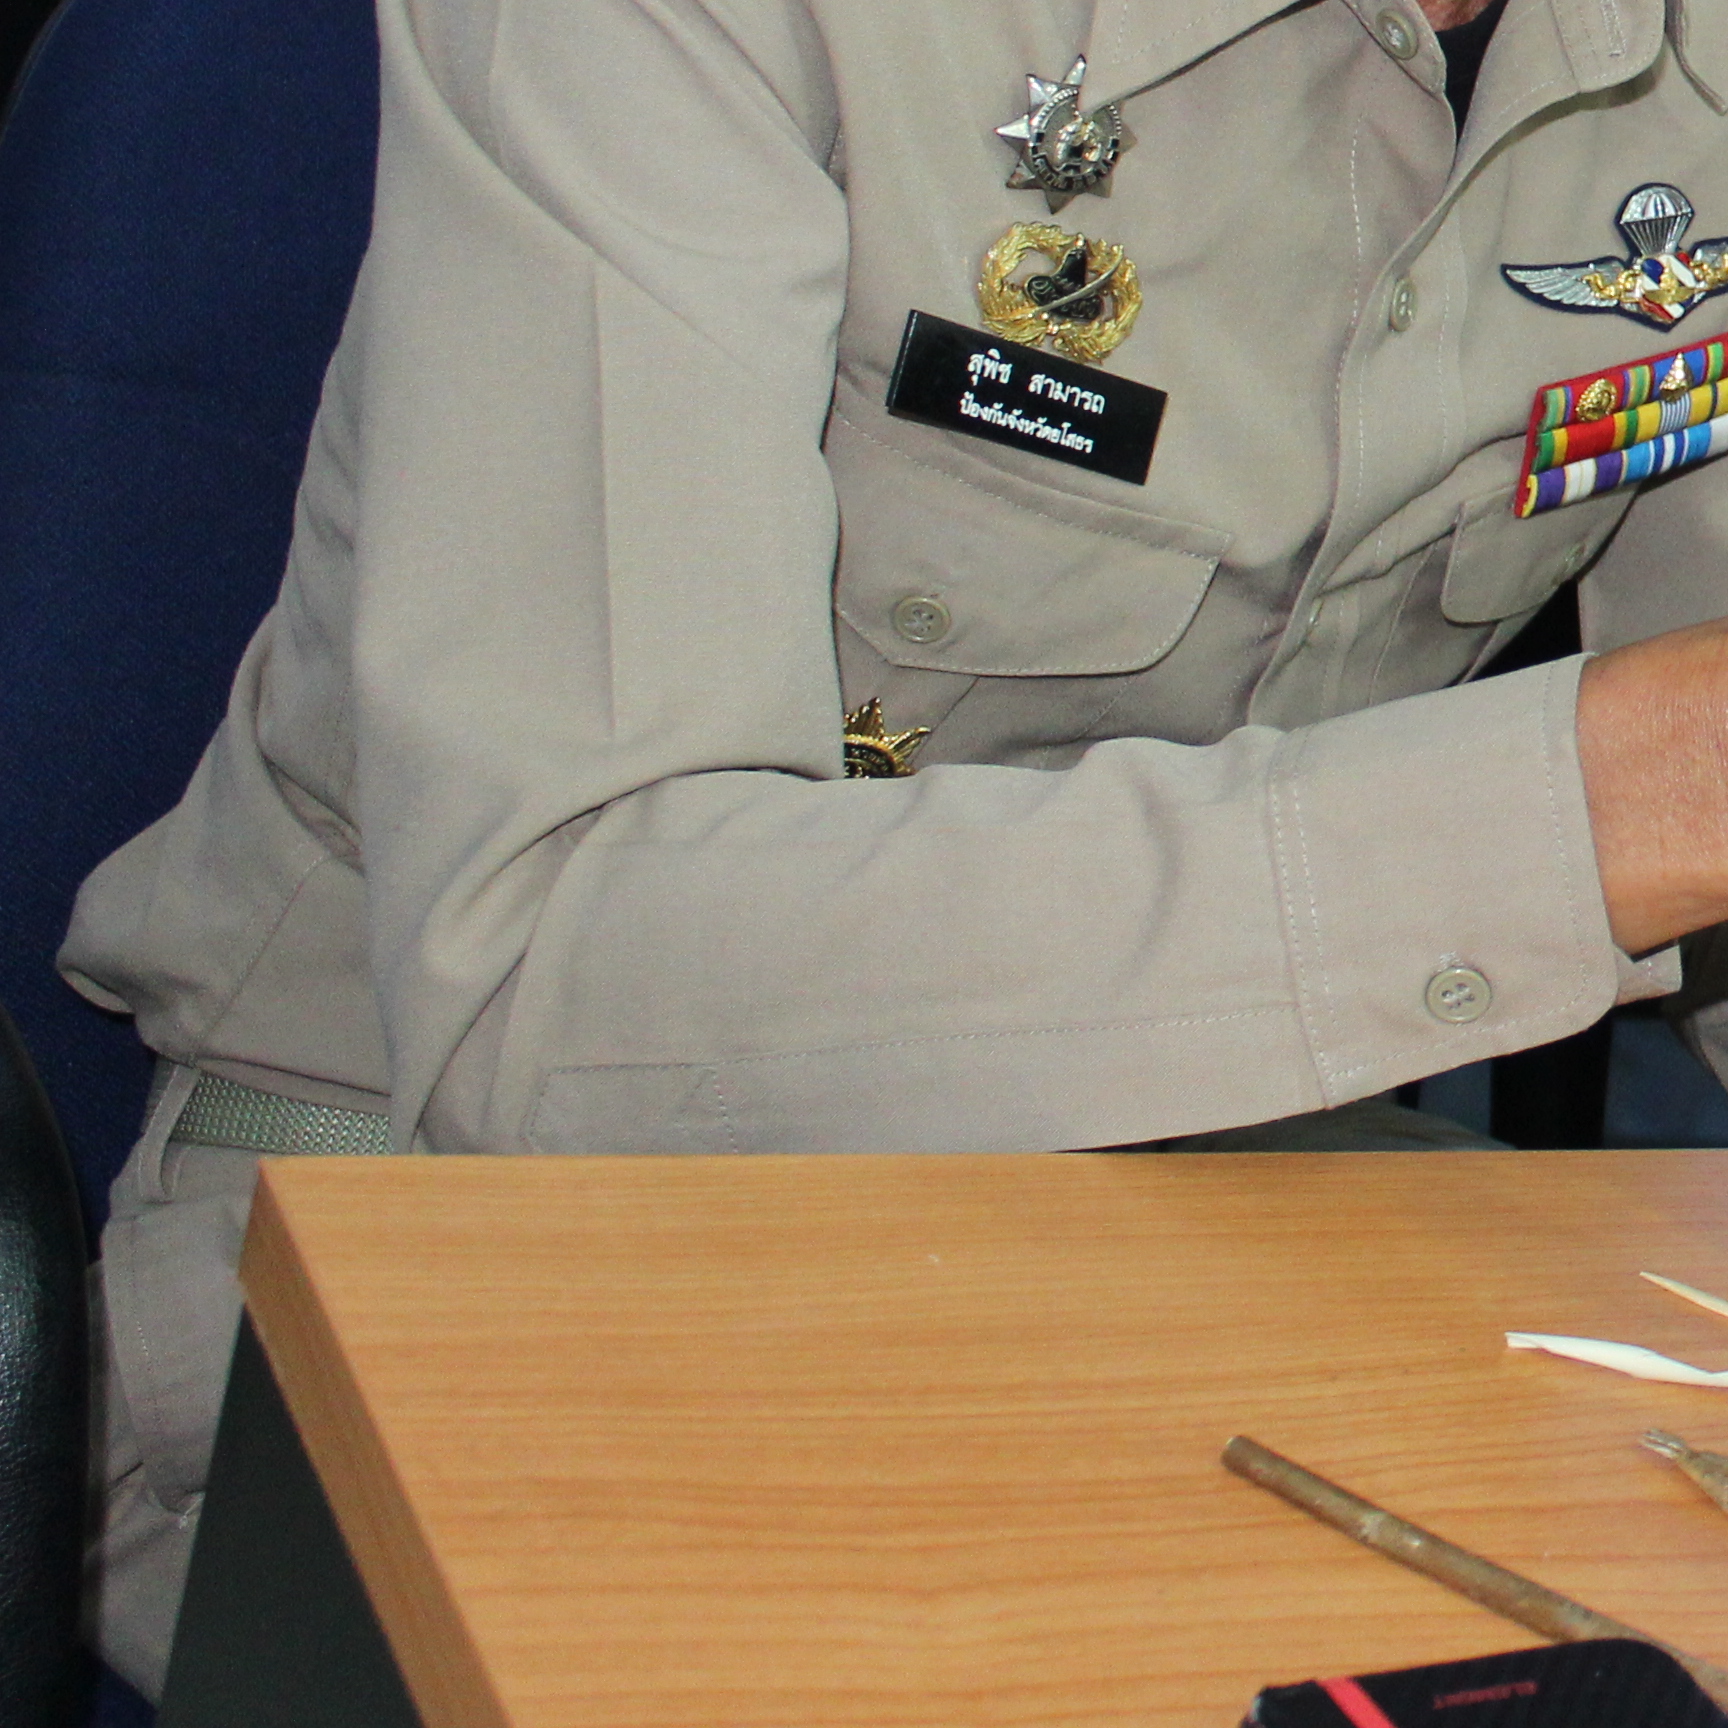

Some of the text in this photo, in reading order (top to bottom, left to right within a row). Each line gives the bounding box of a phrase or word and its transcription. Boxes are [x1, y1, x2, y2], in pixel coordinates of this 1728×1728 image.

[966, 348, 1107, 415] สุพิช สามารถ
[958, 391, 1094, 454] ป้องกันจังหวัดยโสธร
